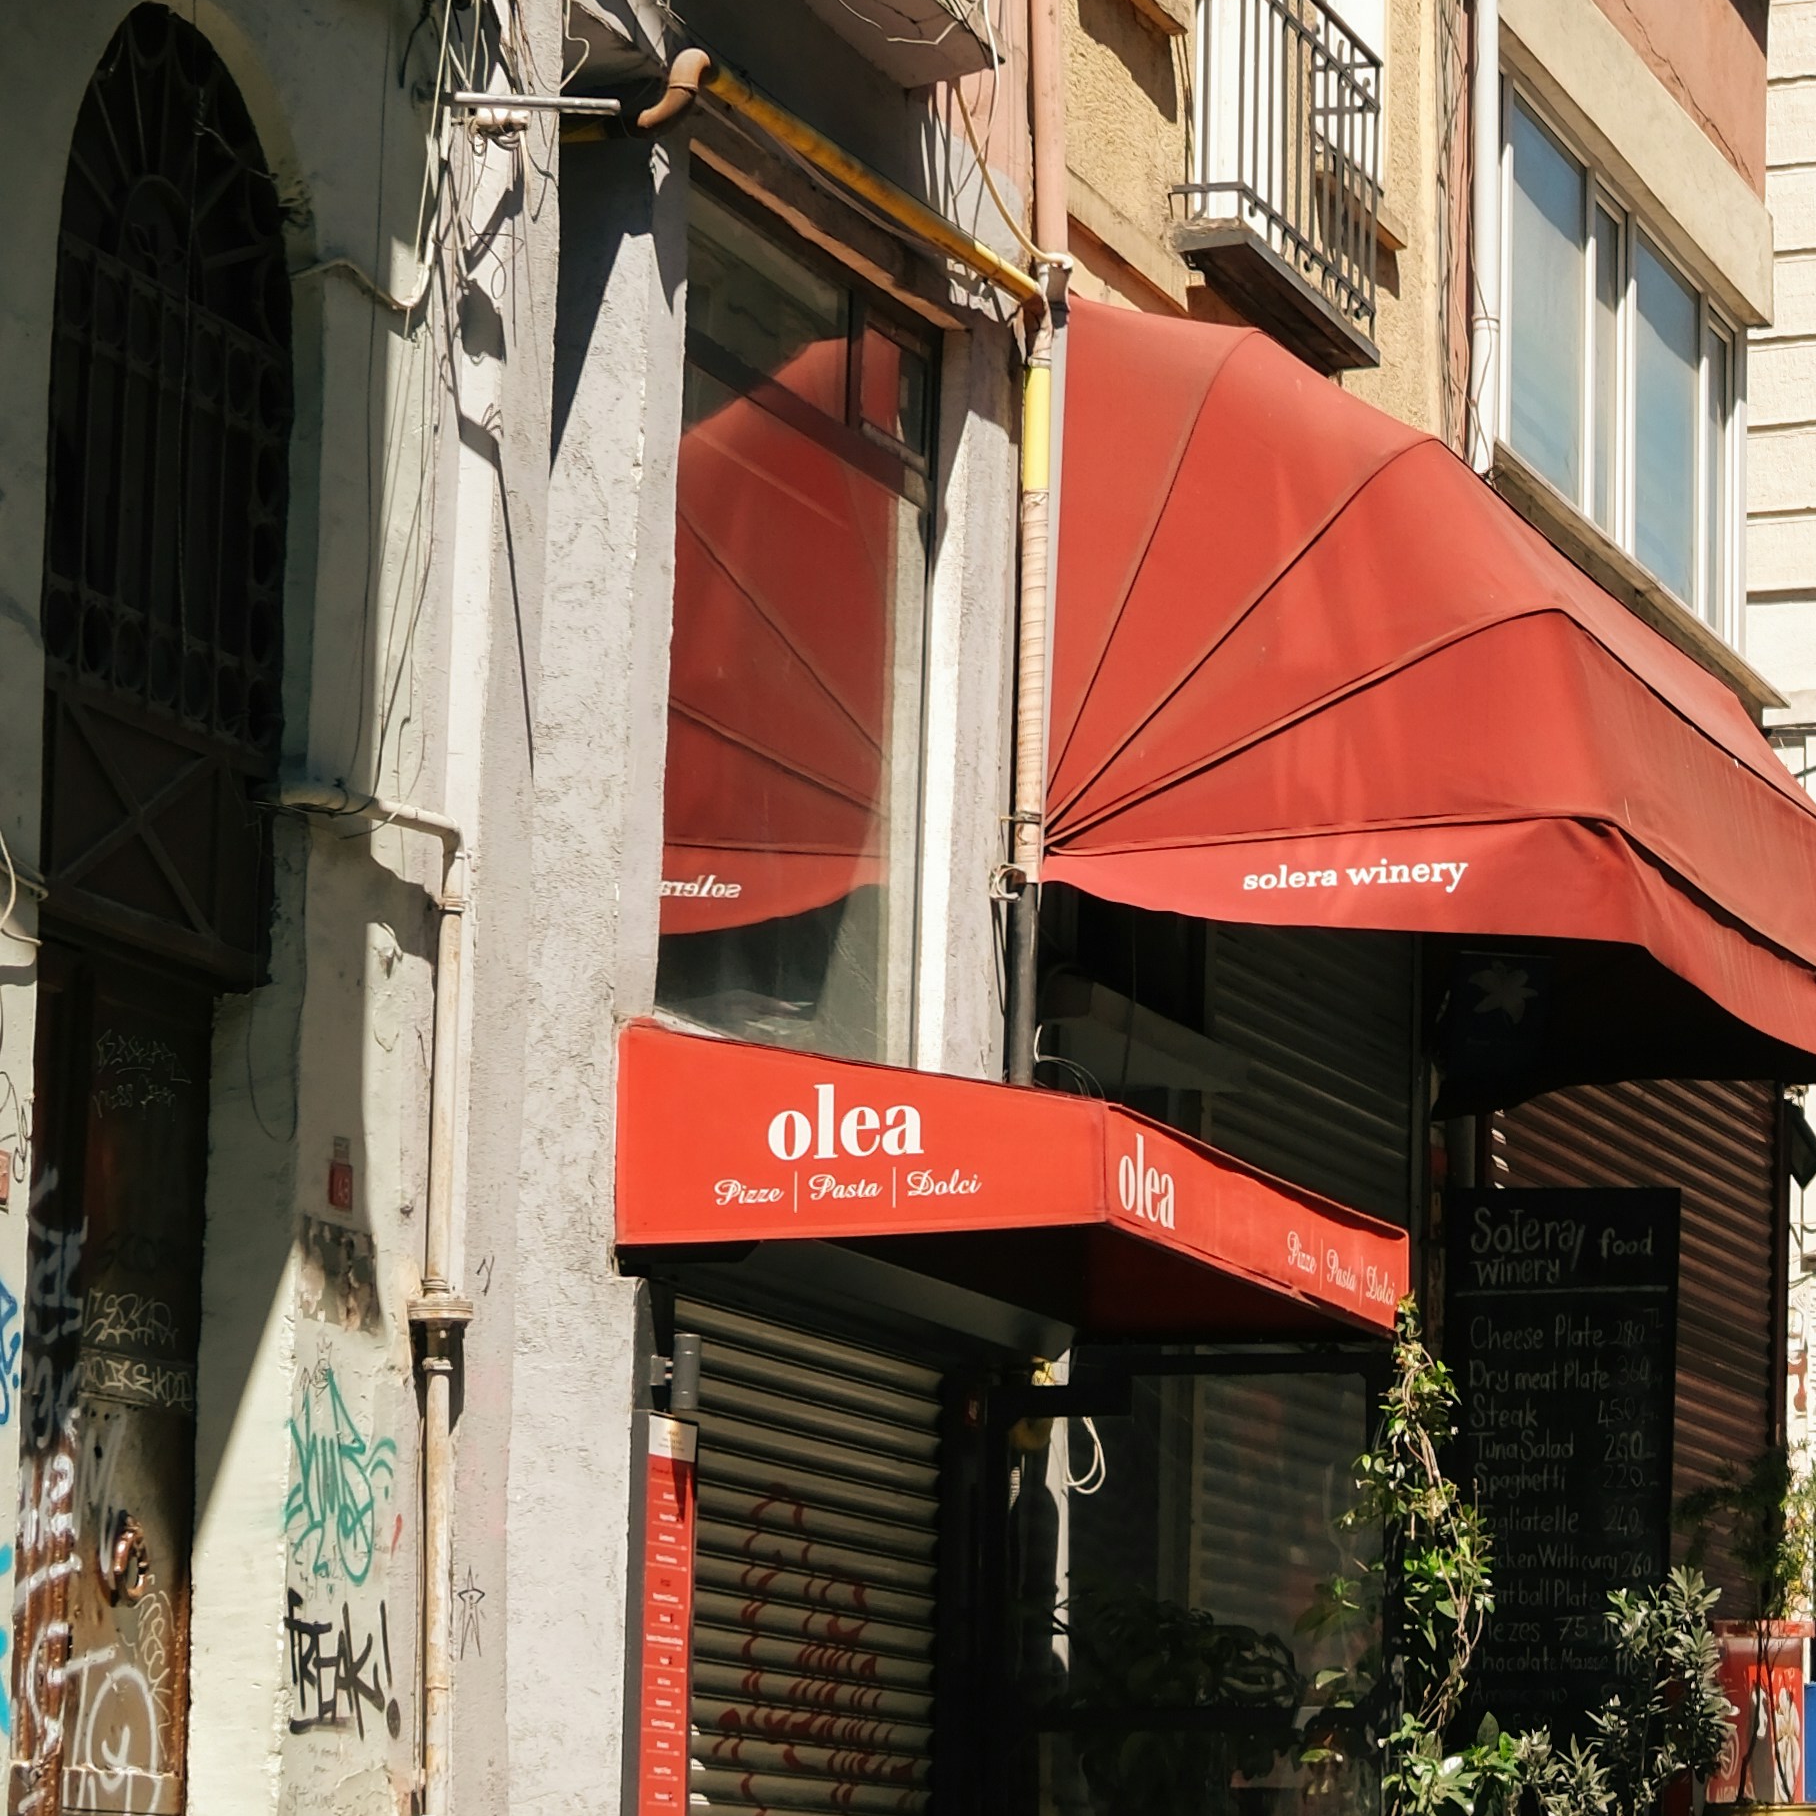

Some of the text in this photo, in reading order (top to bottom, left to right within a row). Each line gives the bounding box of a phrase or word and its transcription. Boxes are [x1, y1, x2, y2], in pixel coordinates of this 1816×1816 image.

[1242, 858, 1468, 893] solera winery
[767, 1084, 925, 1161] olea
[714, 1169, 983, 1206] Pizze Pasta Dolci
[1118, 1133, 1175, 1231] olea
[1597, 1225, 1654, 1259] food
[1287, 1231, 1395, 1306] Pizze Pasta Dolci
[1470, 1315, 1544, 1350] Cheese
[1554, 1313, 1607, 1348] Plate
[1468, 1358, 1509, 1393] Dry
[1514, 1361, 1559, 1391] meat
[1564, 1357, 1611, 1392] Plate
[1470, 1393, 1538, 1428] Steak
[1474, 1462, 1566, 1498] Spaghetti
